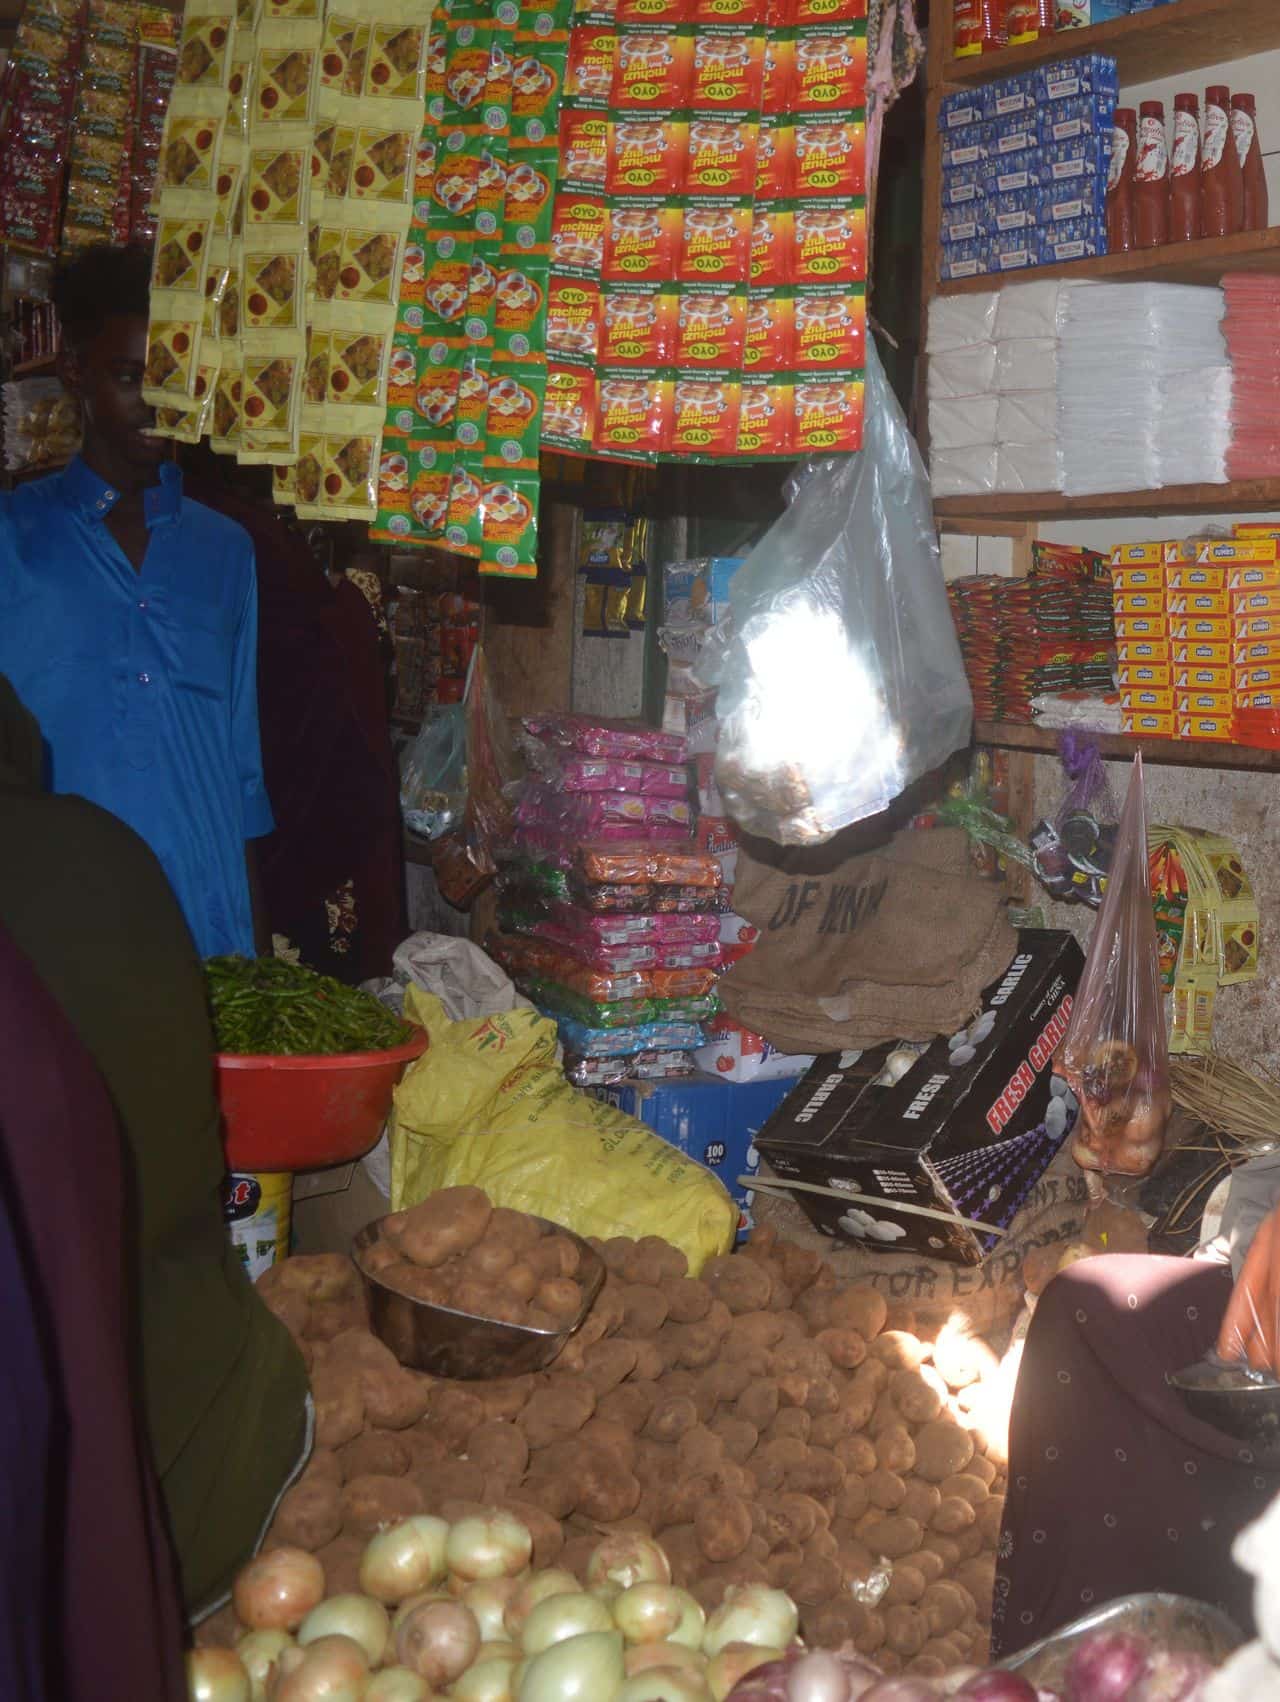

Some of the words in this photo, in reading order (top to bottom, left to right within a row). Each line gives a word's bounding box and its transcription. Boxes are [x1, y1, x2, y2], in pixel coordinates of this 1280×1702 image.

[632, 86, 657, 95] OYO
[708, 87, 734, 96] OYO
[812, 87, 838, 97] OYO
[628, 172, 653, 182] OYO
[701, 172, 727, 182] OYO
[811, 175, 837, 185] OYO
[573, 208, 596, 217] OYO
[623, 258, 648, 268] OYO
[696, 258, 721, 268] OYO
[811, 261, 836, 270] OYO
[562, 291, 584, 300] OYO
[617, 345, 641, 354] OYO
[691, 346, 716, 356] OYO
[811, 348, 836, 357] OYO
[612, 430, 637, 440] OYO
[685, 431, 710, 441] OYO
[810, 433, 835, 443] OYO
[990, 954, 1033, 1006] GARLIC
[794, 1073, 844, 1122] GARLIC
[902, 1074, 949, 1119] FRESH
[986, 1059, 1036, 1135] FRESH
[707, 1144, 724, 1158] 100
